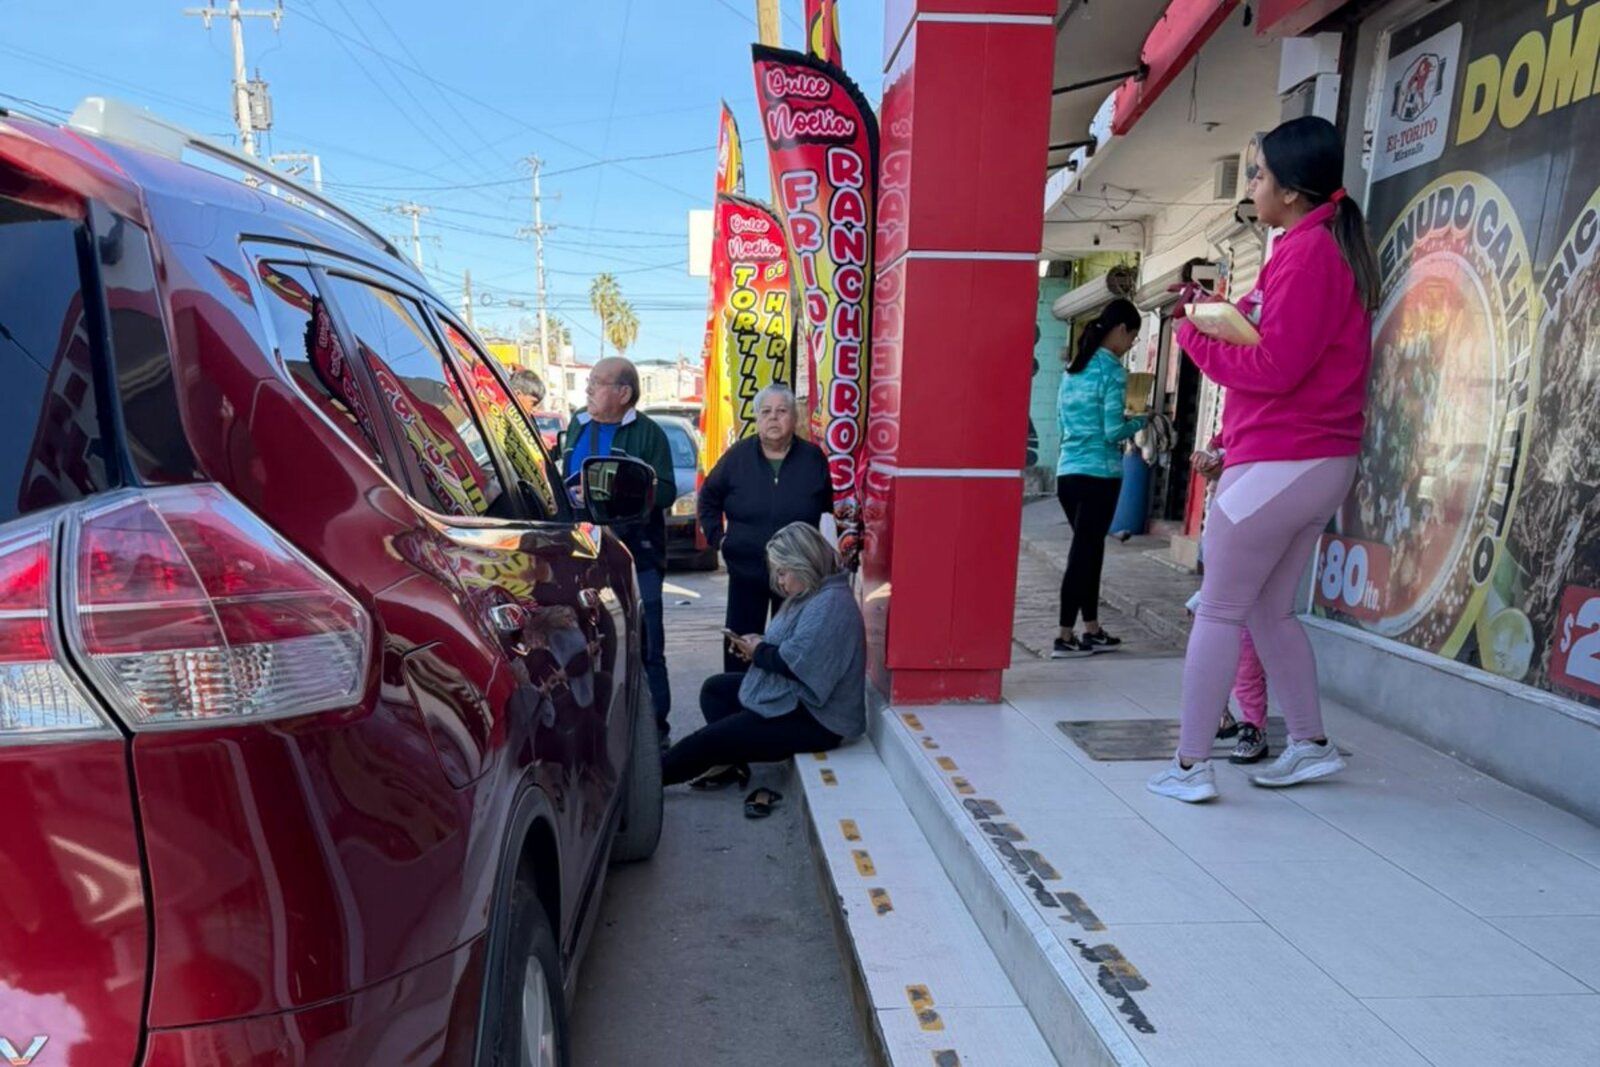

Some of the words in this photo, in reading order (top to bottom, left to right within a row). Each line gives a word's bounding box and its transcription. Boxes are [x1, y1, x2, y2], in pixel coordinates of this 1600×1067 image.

[766, 68, 831, 97] Dulce
[767, 103, 856, 141] Noelia
[1456, 1, 1600, 146] DOM
[766, 262, 785, 282] DE
[1379, 183, 1476, 291] ENUDO
[1540, 208, 1600, 314] RIC
[764, 291, 788, 386] HARI
[780, 169, 830, 415] FRIJ
[826, 148, 868, 491] RANCHEROS
[1560, 597, 1600, 686] $2
